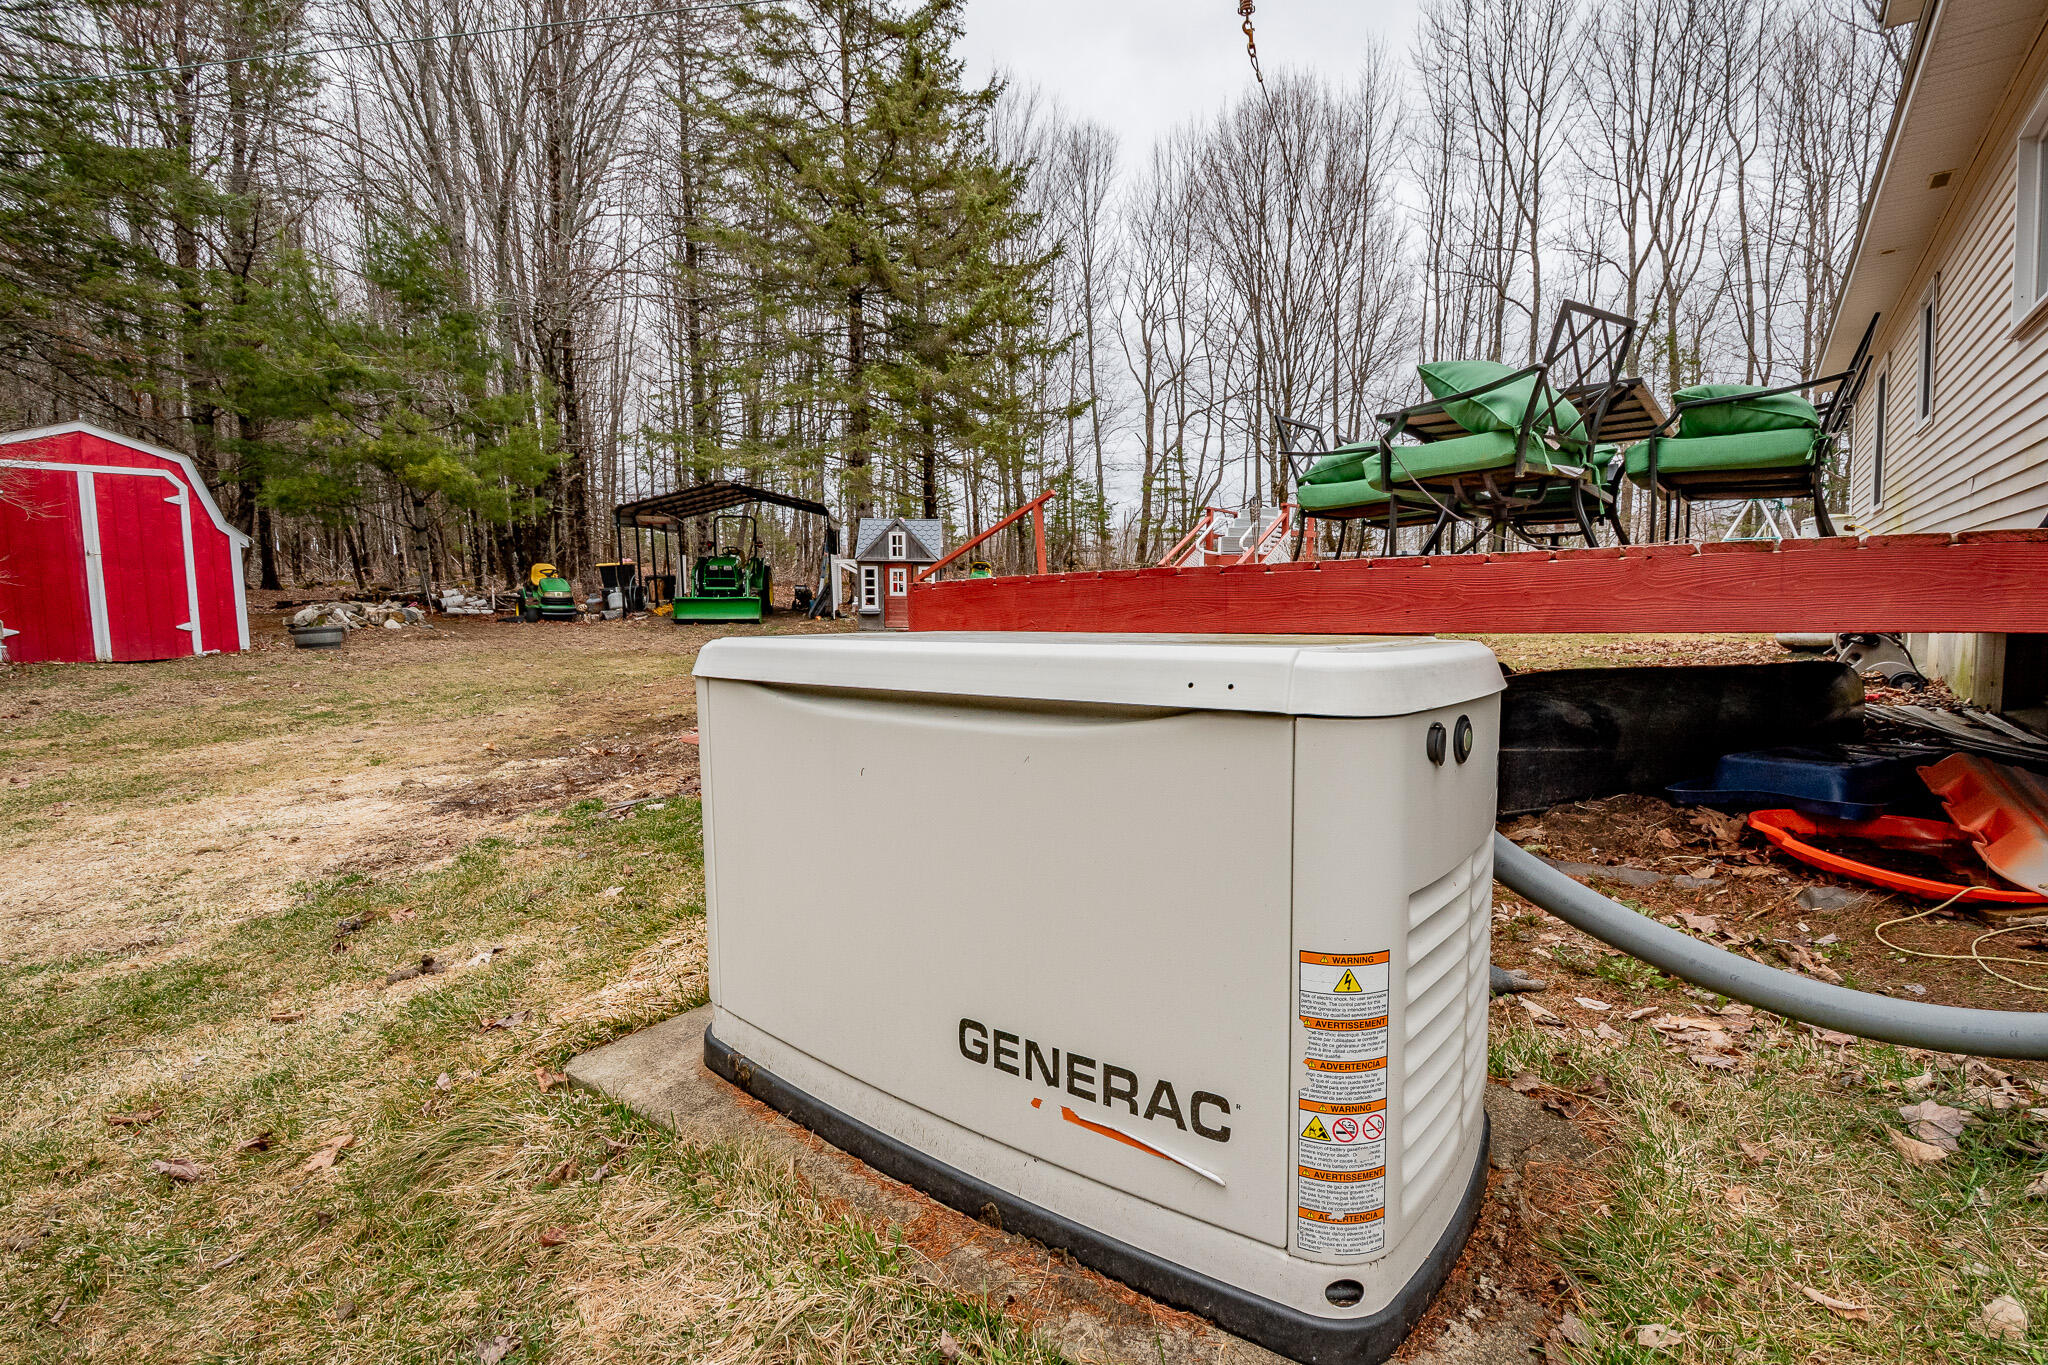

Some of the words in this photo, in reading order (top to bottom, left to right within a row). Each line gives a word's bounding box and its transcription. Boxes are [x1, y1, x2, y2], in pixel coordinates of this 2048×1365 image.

[1332, 956, 1374, 964] WARNING
[1315, 1018, 1386, 1029] AVERTISSEMENT
[1320, 1061, 1380, 1070] ADVERTENCIA
[959, 1018, 1231, 1143] GENERAC
[1331, 1104, 1371, 1112] WARNING
[1314, 1168, 1383, 1181] AVERTISSEMENT
